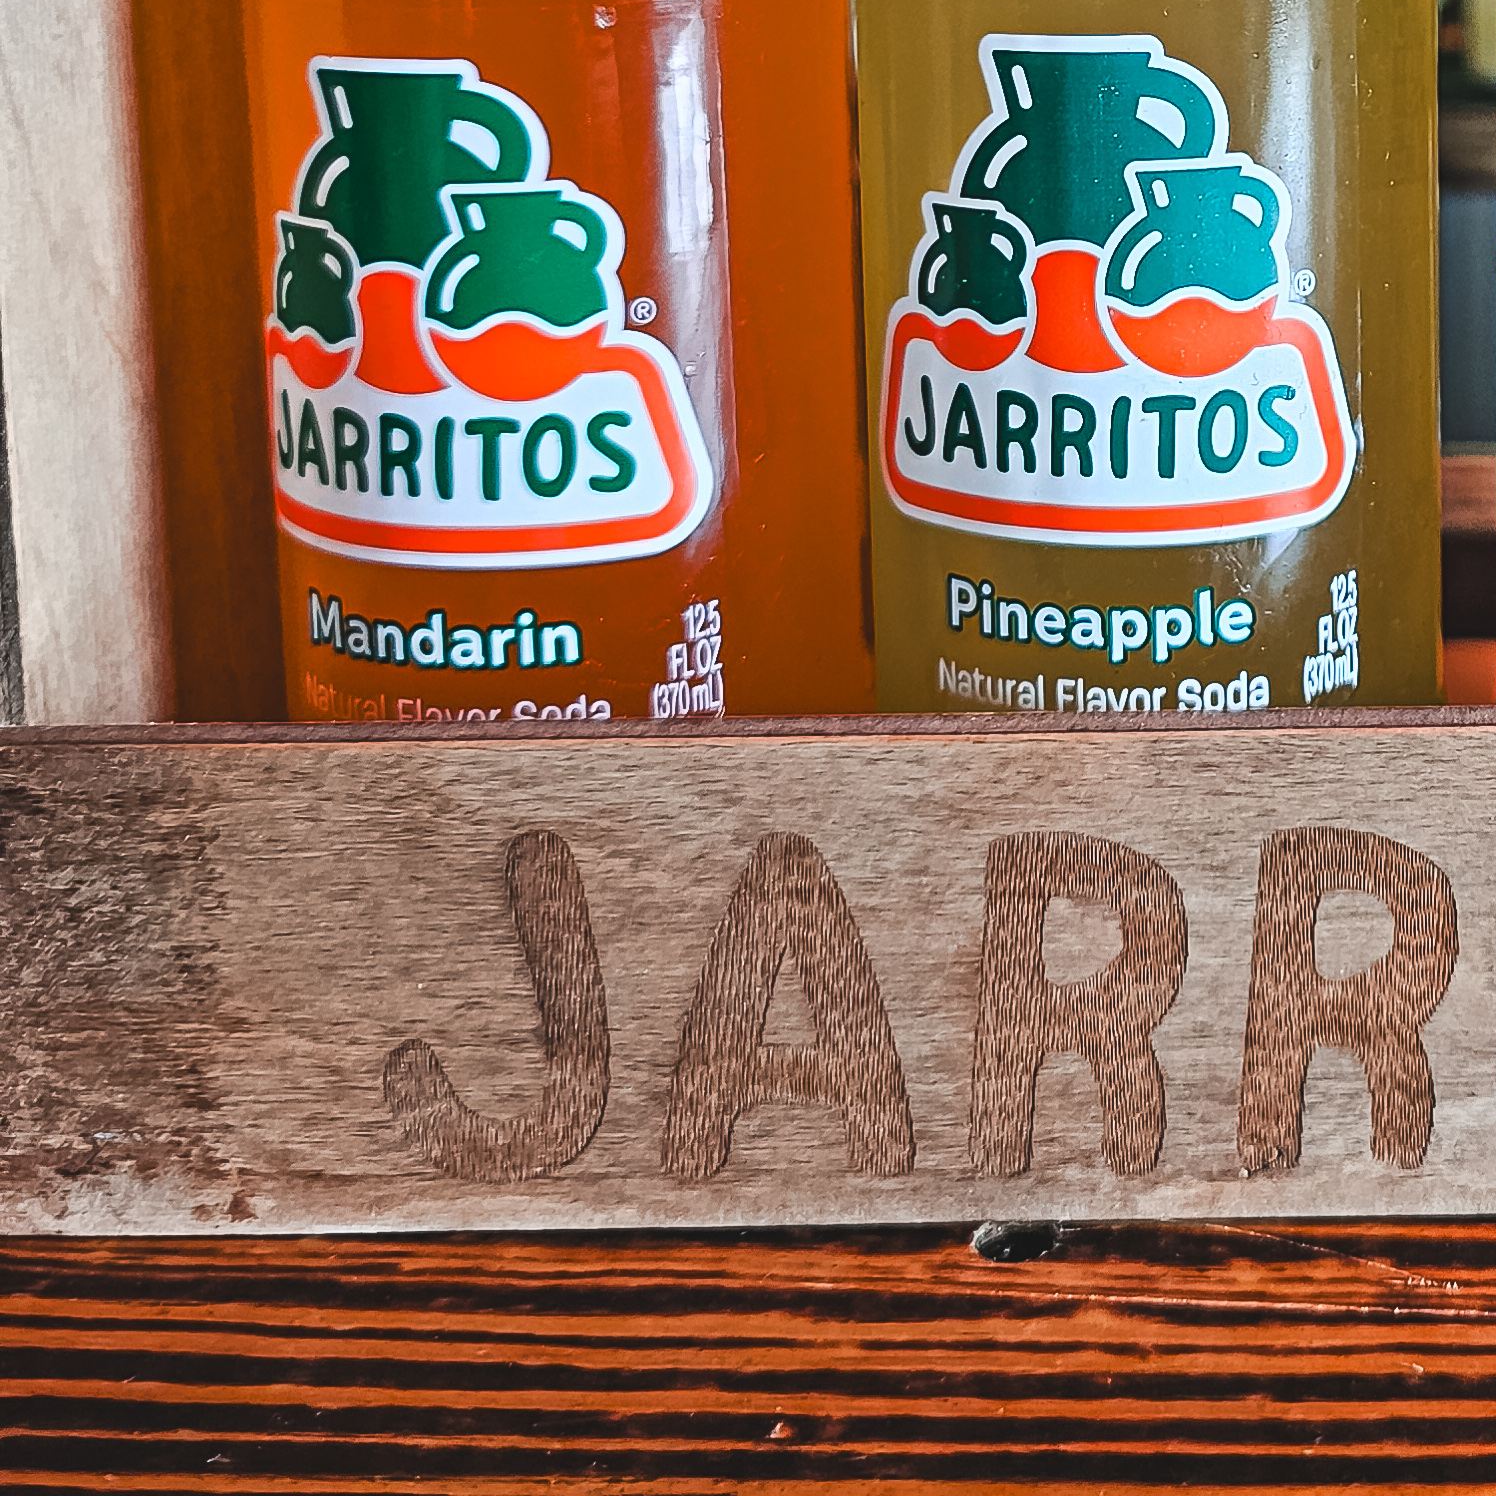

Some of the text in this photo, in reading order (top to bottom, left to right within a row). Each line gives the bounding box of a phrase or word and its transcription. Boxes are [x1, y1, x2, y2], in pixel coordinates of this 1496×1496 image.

[276, 388, 637, 502] JARRITOS
[903, 374, 1299, 480] JARRITOS
[308, 589, 581, 670] Mandarin
[667, 634, 723, 681] FL OZ
[947, 573, 1256, 664] Pineapple
[1318, 605, 1359, 655] FL OZ
[938, 656, 1271, 713] Natural Flavor Soda
